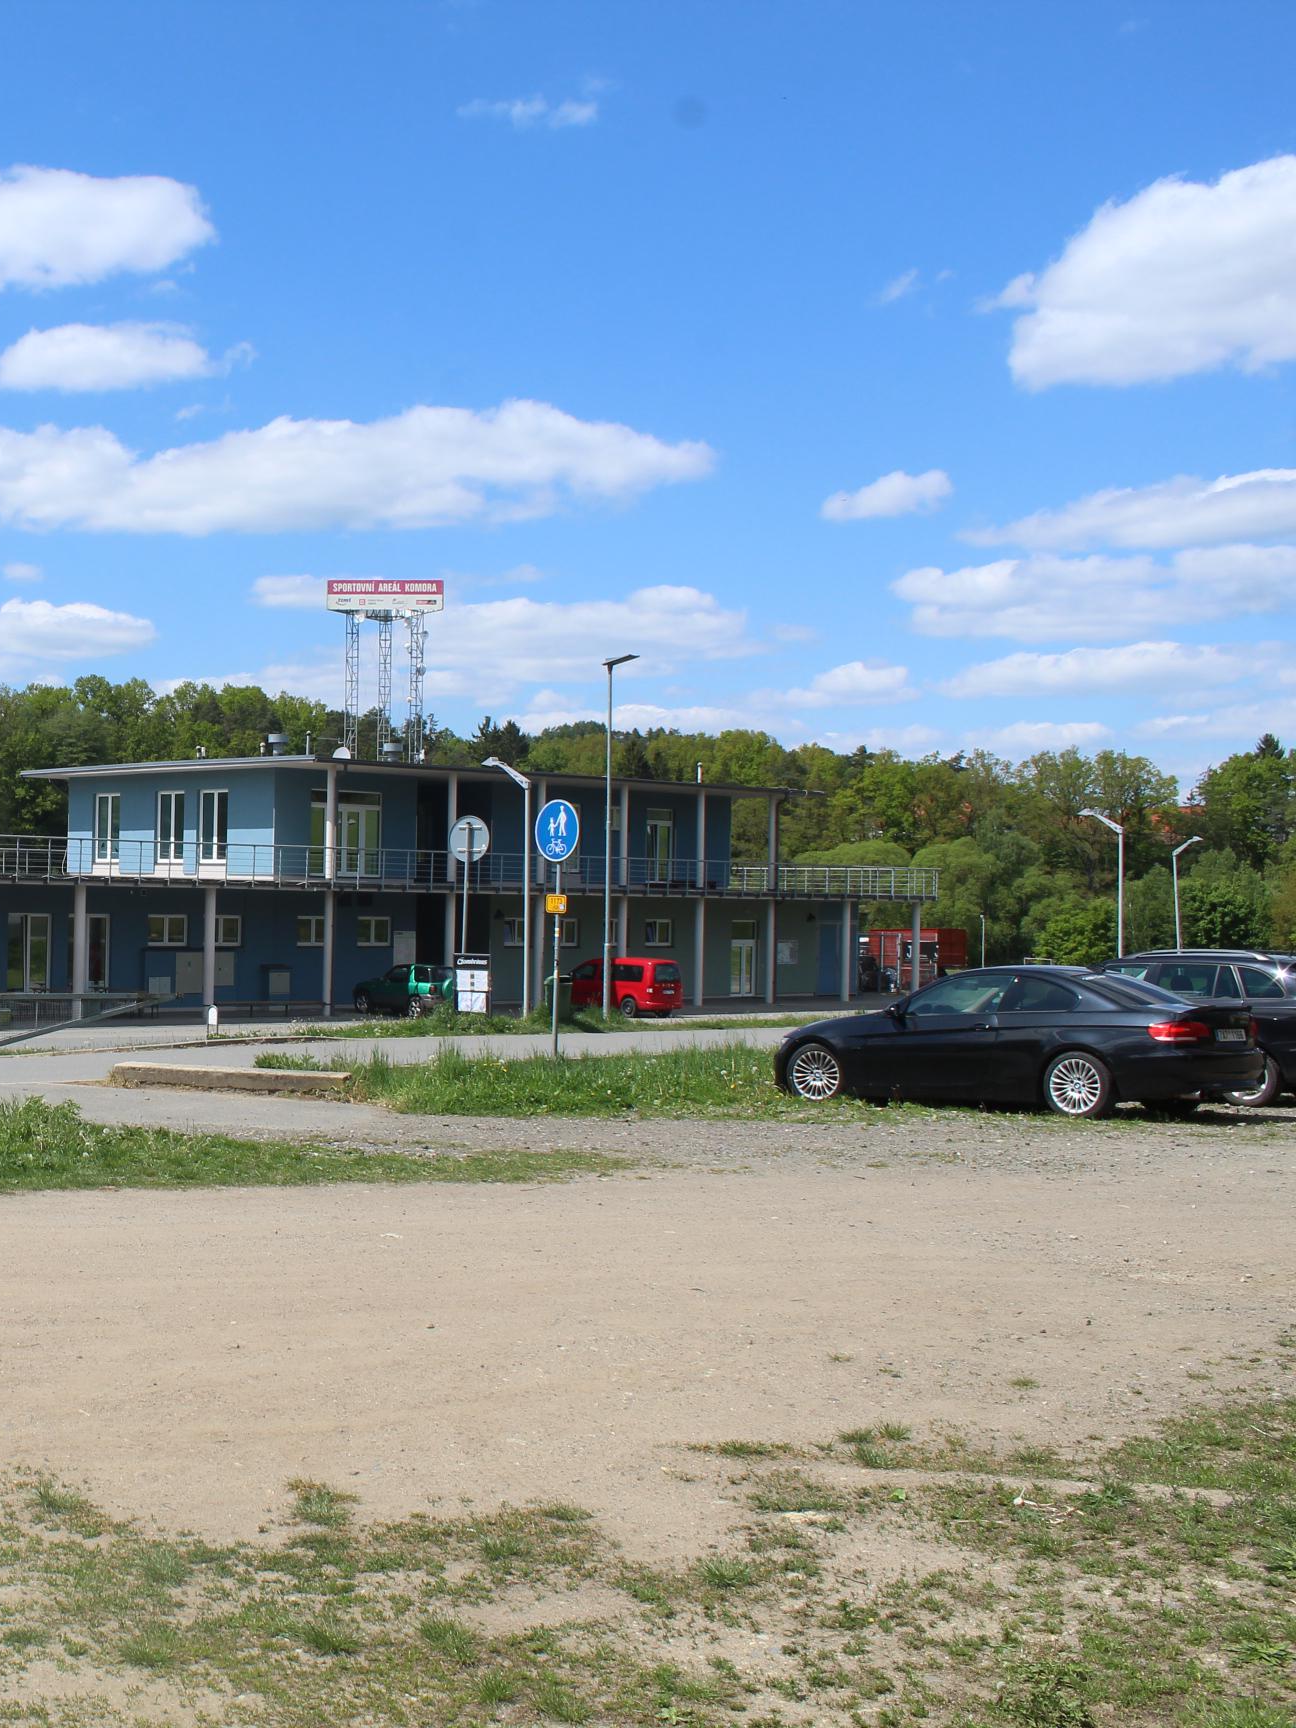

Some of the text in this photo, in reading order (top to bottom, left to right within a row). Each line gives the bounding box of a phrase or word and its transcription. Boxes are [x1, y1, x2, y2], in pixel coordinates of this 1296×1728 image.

[332, 581, 437, 593] SPORTOVNÍ AREÁL KOMORA
